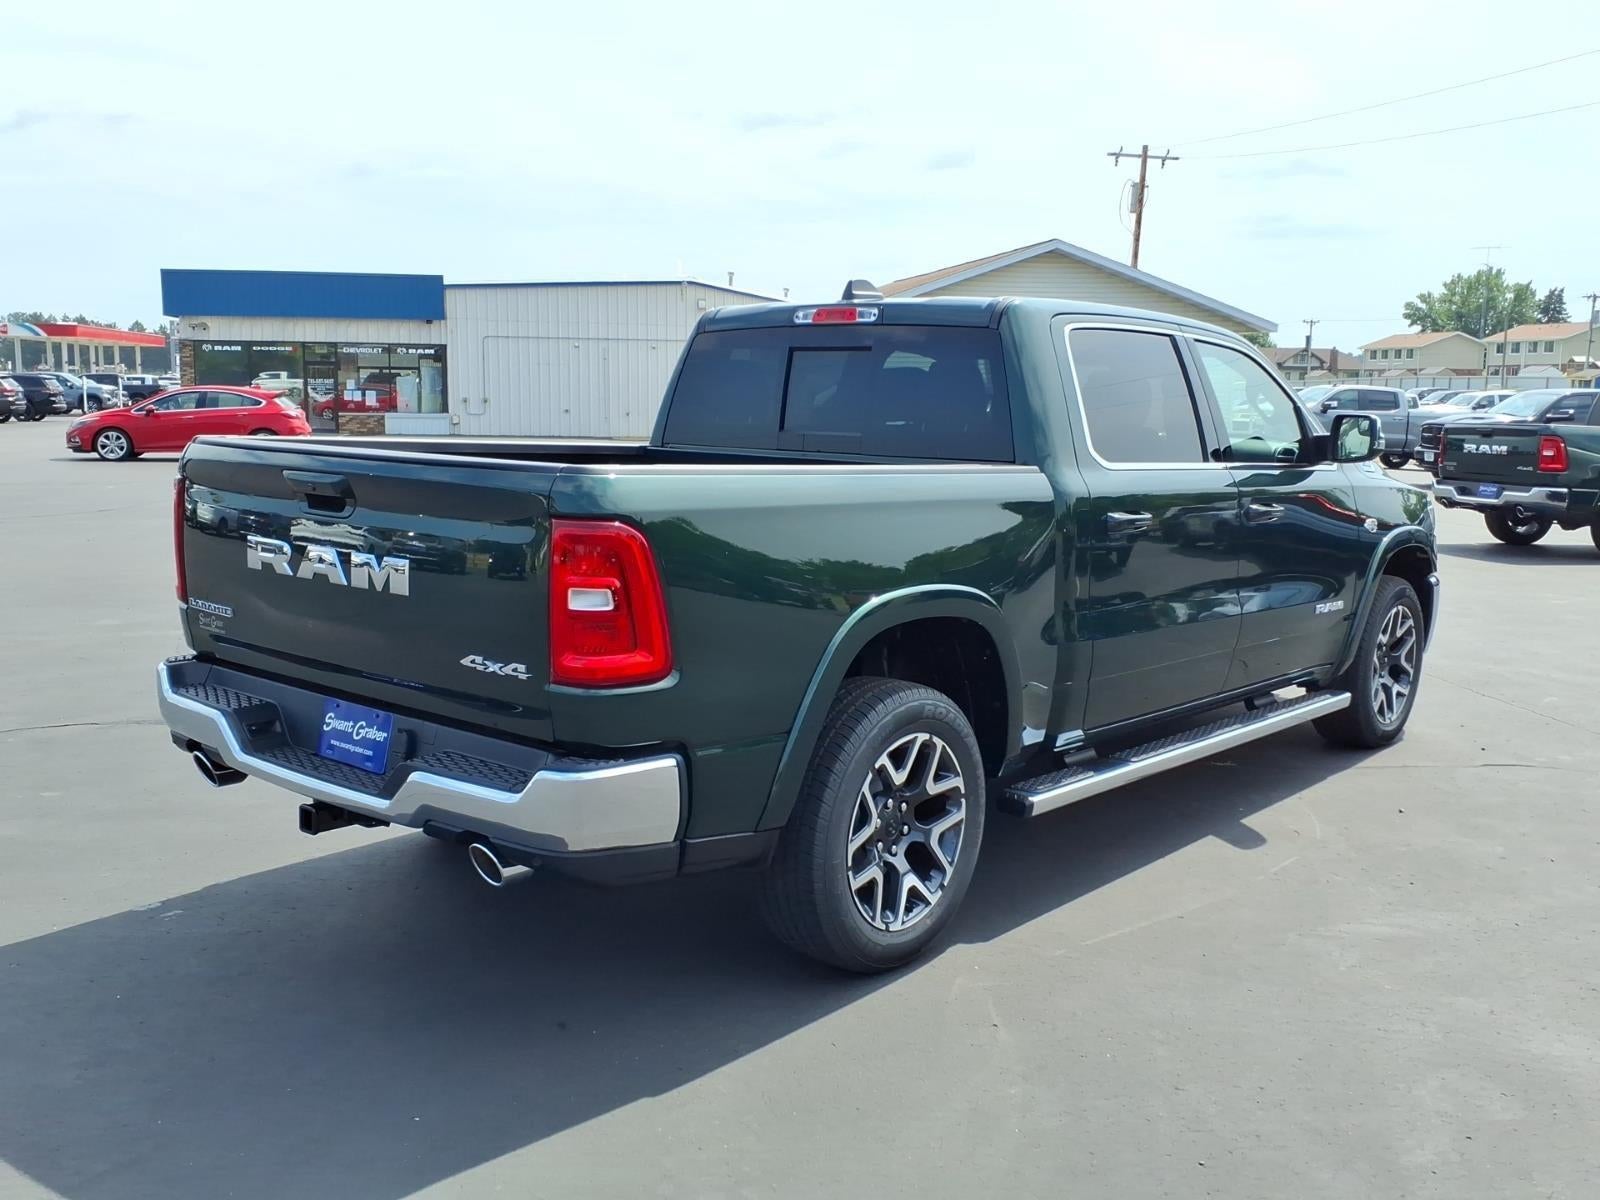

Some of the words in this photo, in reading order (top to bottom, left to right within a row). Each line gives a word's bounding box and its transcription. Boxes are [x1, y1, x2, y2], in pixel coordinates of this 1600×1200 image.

[1463, 443, 1508, 455] RAM
[246, 535, 410, 596] RAM
[188, 597, 234, 618] LARAMIE
[1315, 600, 1345, 614] RAM
[459, 654, 532, 680] 4x4
[322, 712, 355, 733] Swant
[353, 721, 388, 742] Graber
